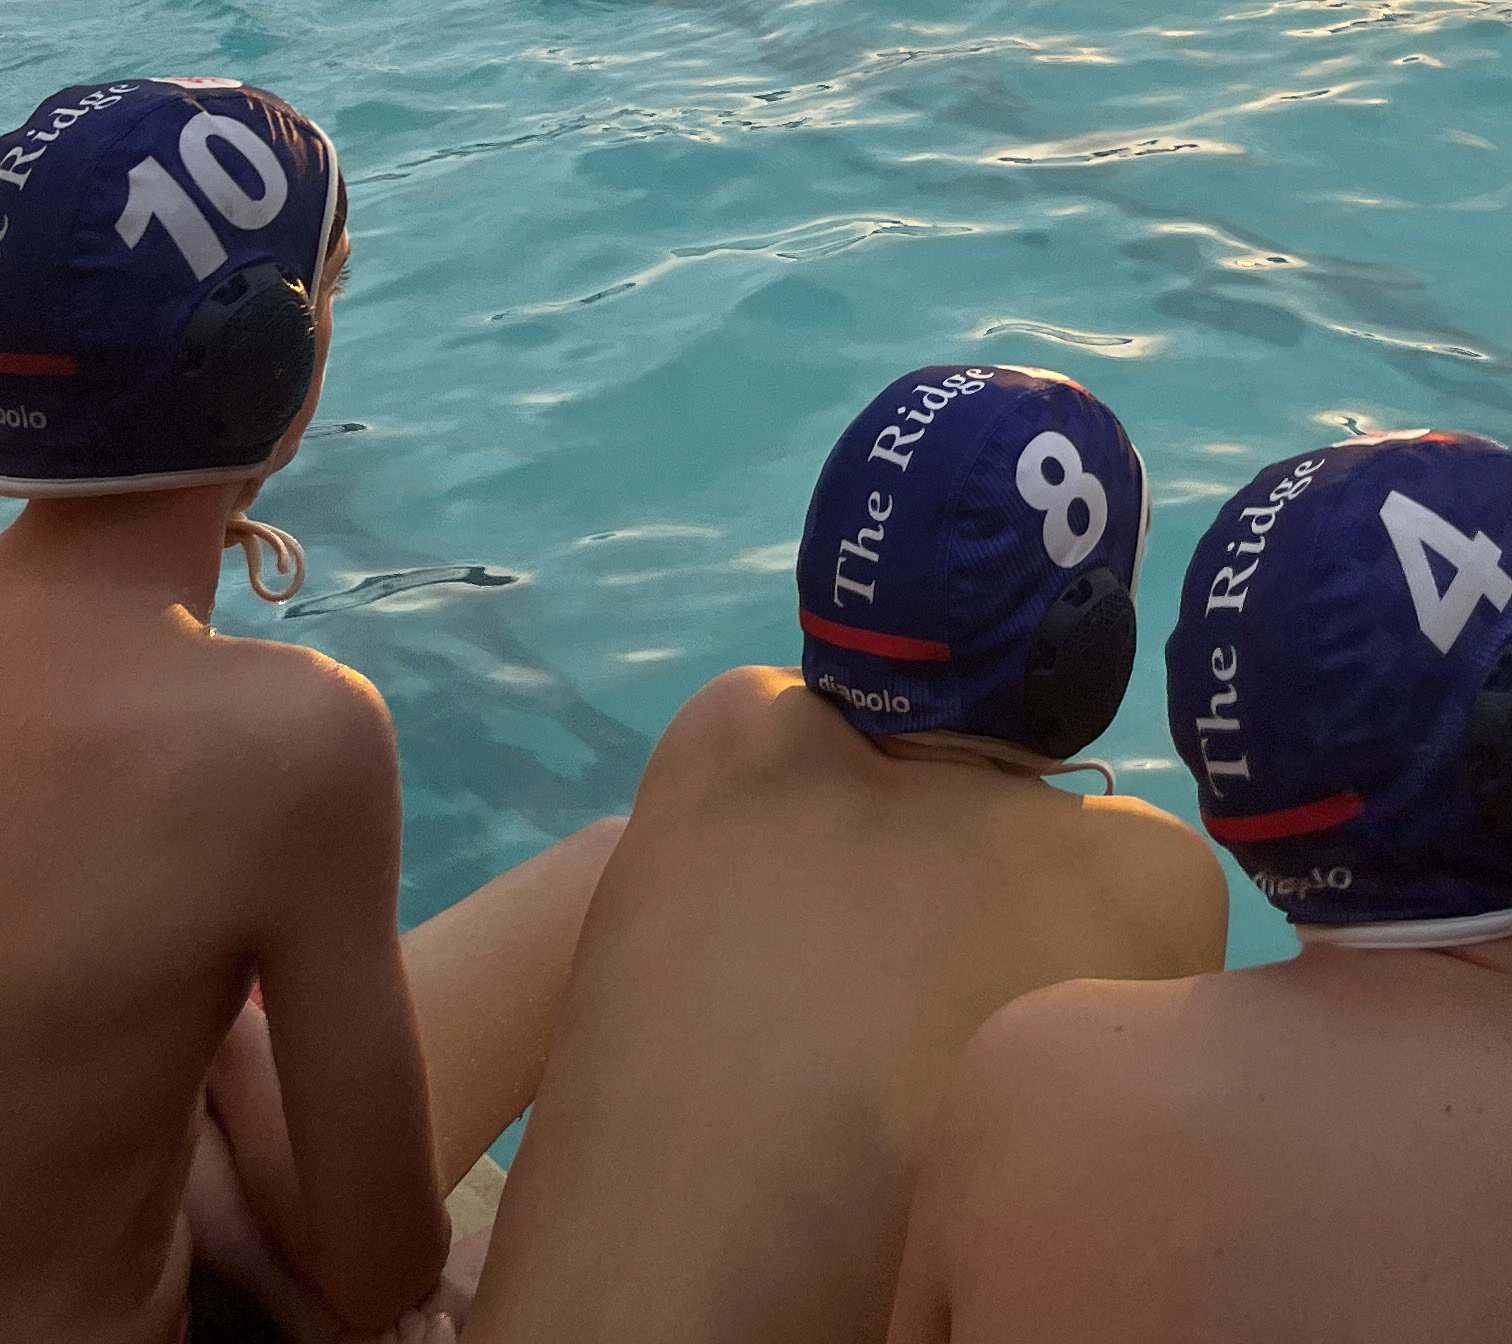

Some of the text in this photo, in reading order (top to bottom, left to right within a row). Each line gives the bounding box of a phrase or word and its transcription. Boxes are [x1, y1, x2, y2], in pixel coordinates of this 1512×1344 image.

[0, 83, 140, 191] Ridge
[114, 111, 288, 282] 10
[834, 367, 995, 608] The Ridge
[1016, 431, 1108, 569] 8
[818, 673, 911, 713] diapolo
[1196, 457, 1326, 799] The Ridge
